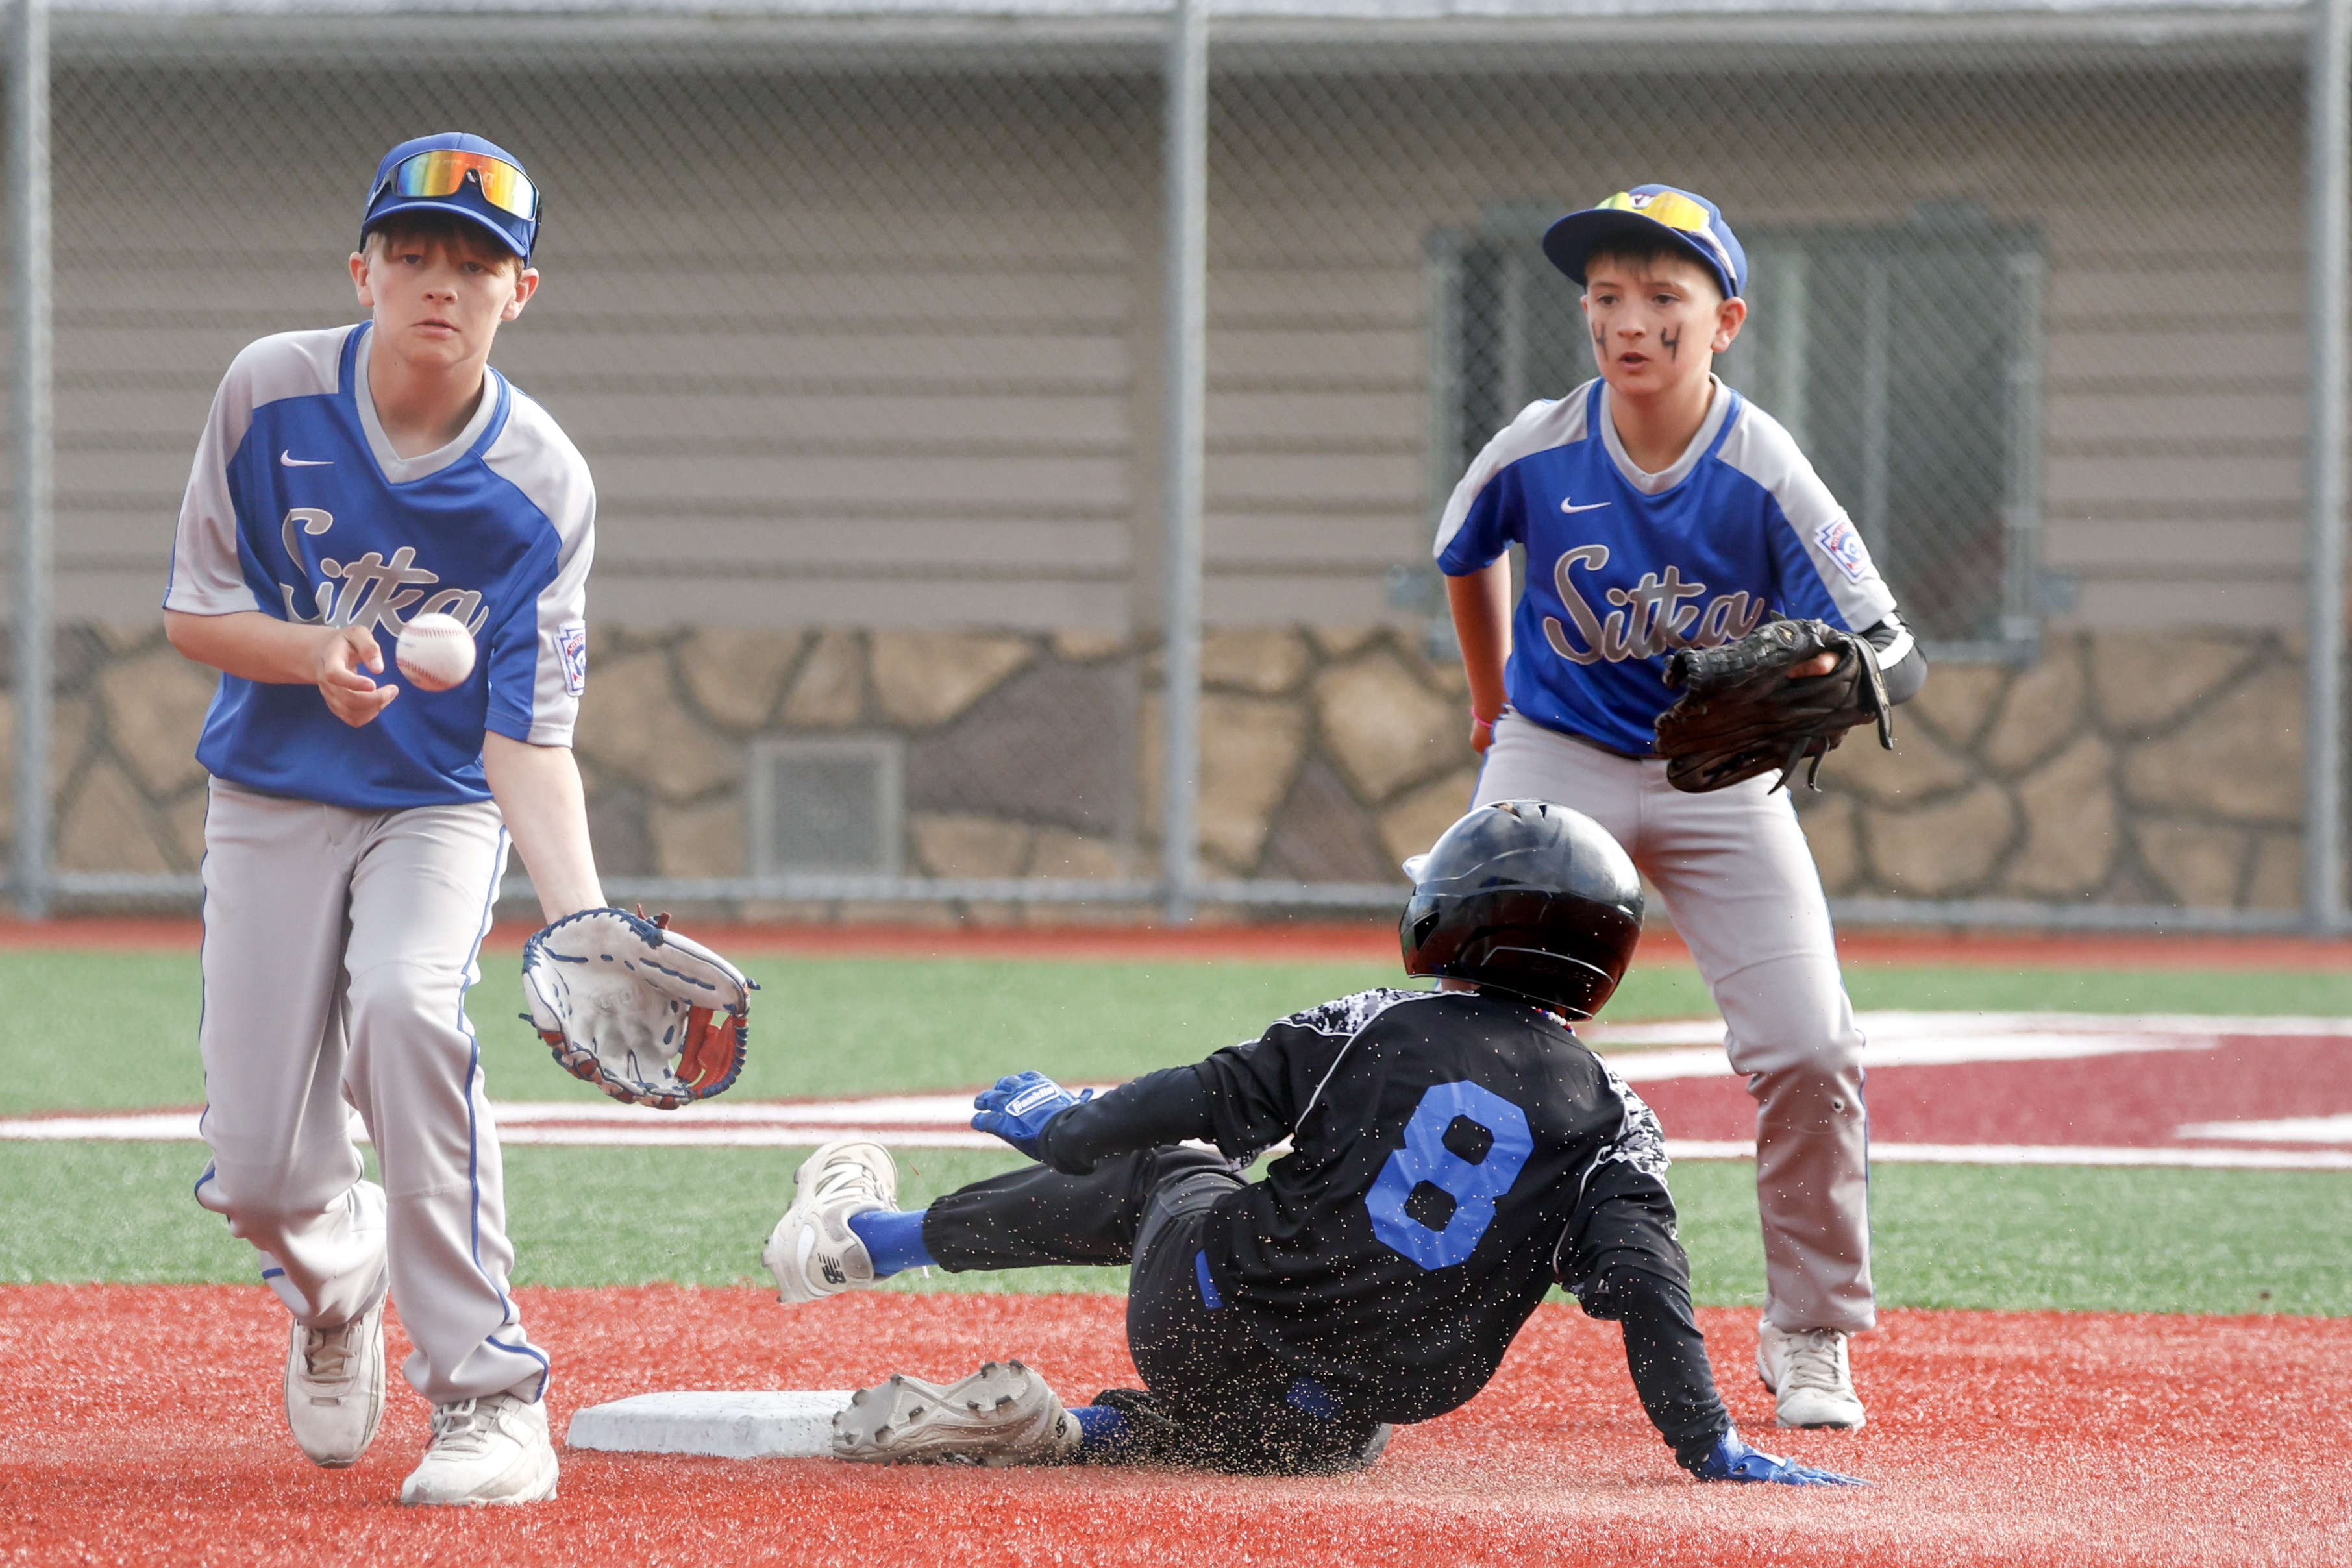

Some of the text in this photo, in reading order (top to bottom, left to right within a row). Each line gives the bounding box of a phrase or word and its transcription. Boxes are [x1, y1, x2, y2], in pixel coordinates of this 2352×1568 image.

[1591, 322, 1608, 359] 4
[1660, 325, 1682, 361] 4
[279, 507, 489, 638] Sitka
[1542, 544, 1766, 665] Sitka
[1012, 1086, 1055, 1114] Franklin
[1365, 1079, 1535, 1271] 8
